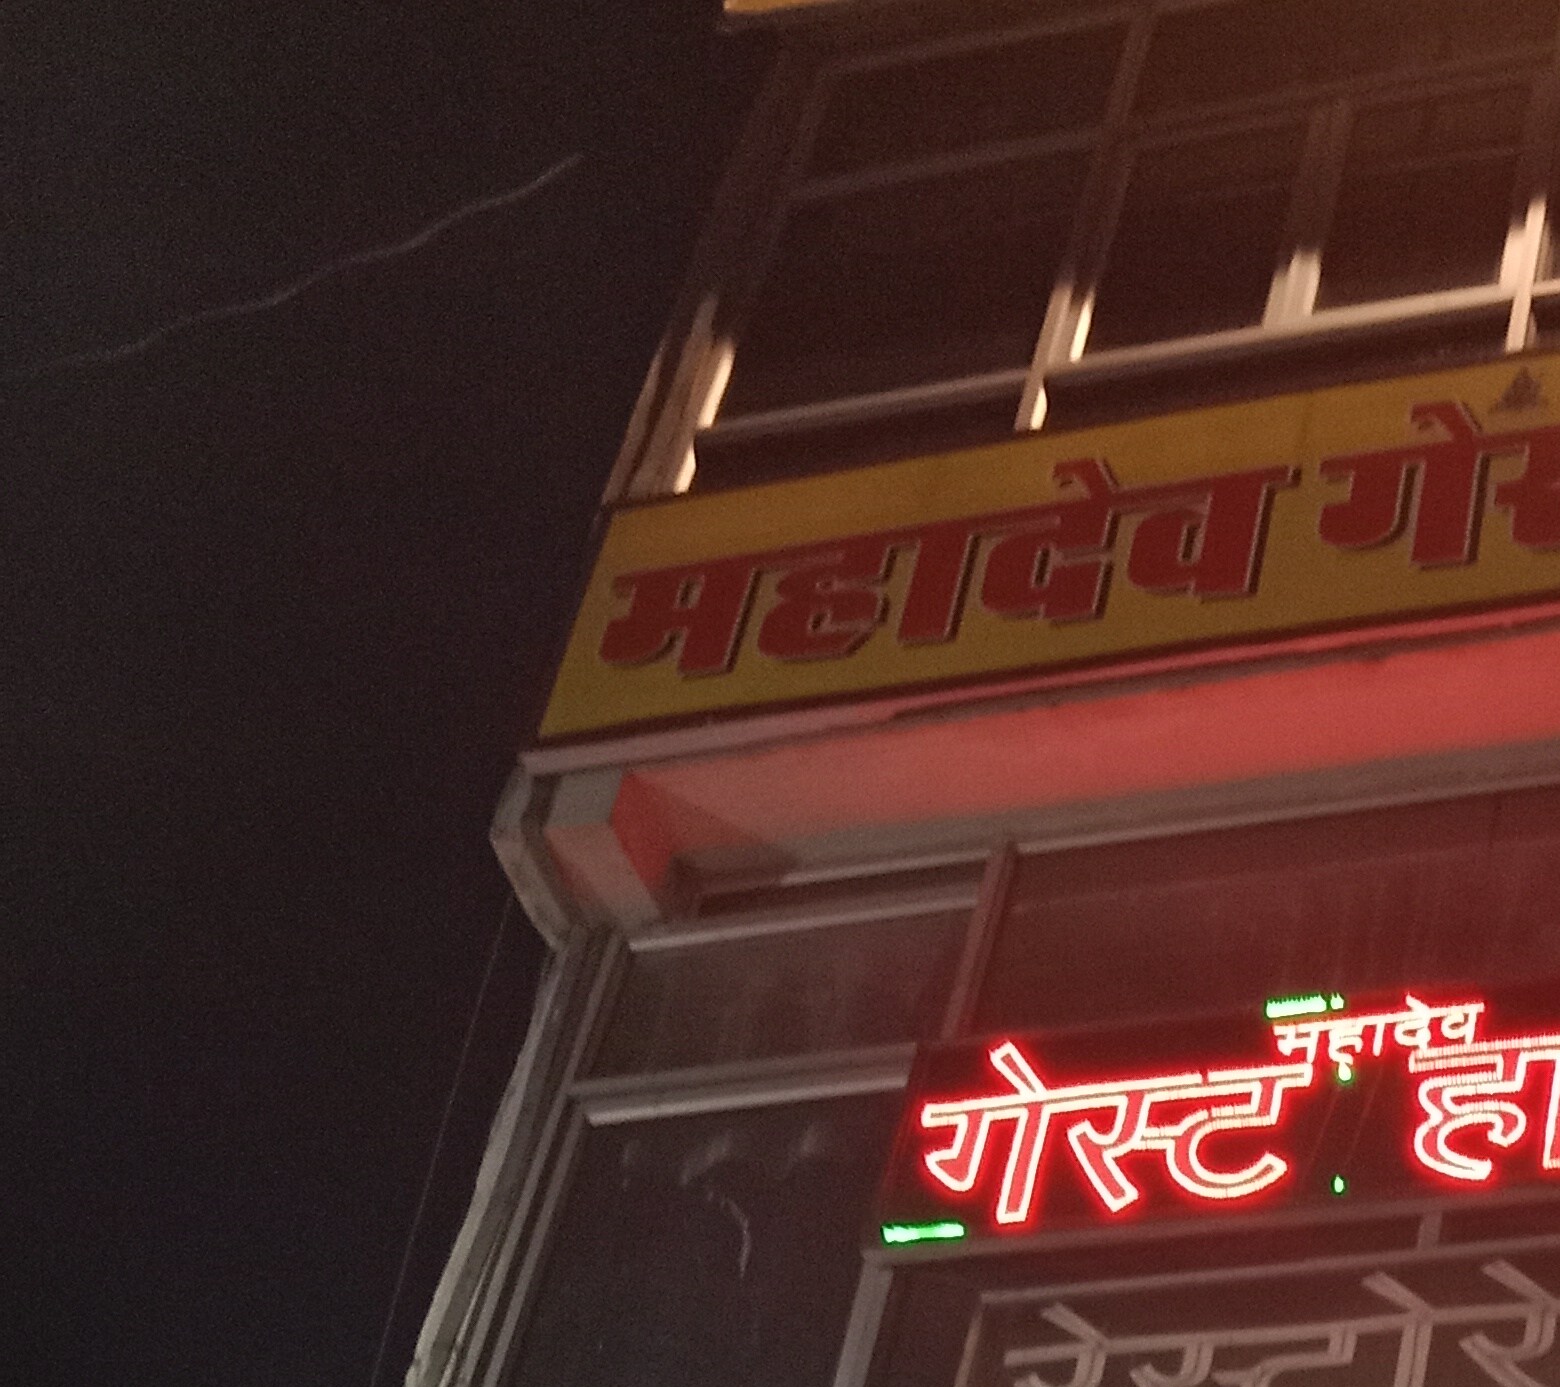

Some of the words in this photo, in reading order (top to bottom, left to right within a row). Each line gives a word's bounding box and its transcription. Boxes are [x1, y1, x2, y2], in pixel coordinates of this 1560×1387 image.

[600, 457, 1300, 678] महादेव
[1273, 992, 1485, 1068] महादेव
[921, 1040, 1313, 1224] गेस्ट
